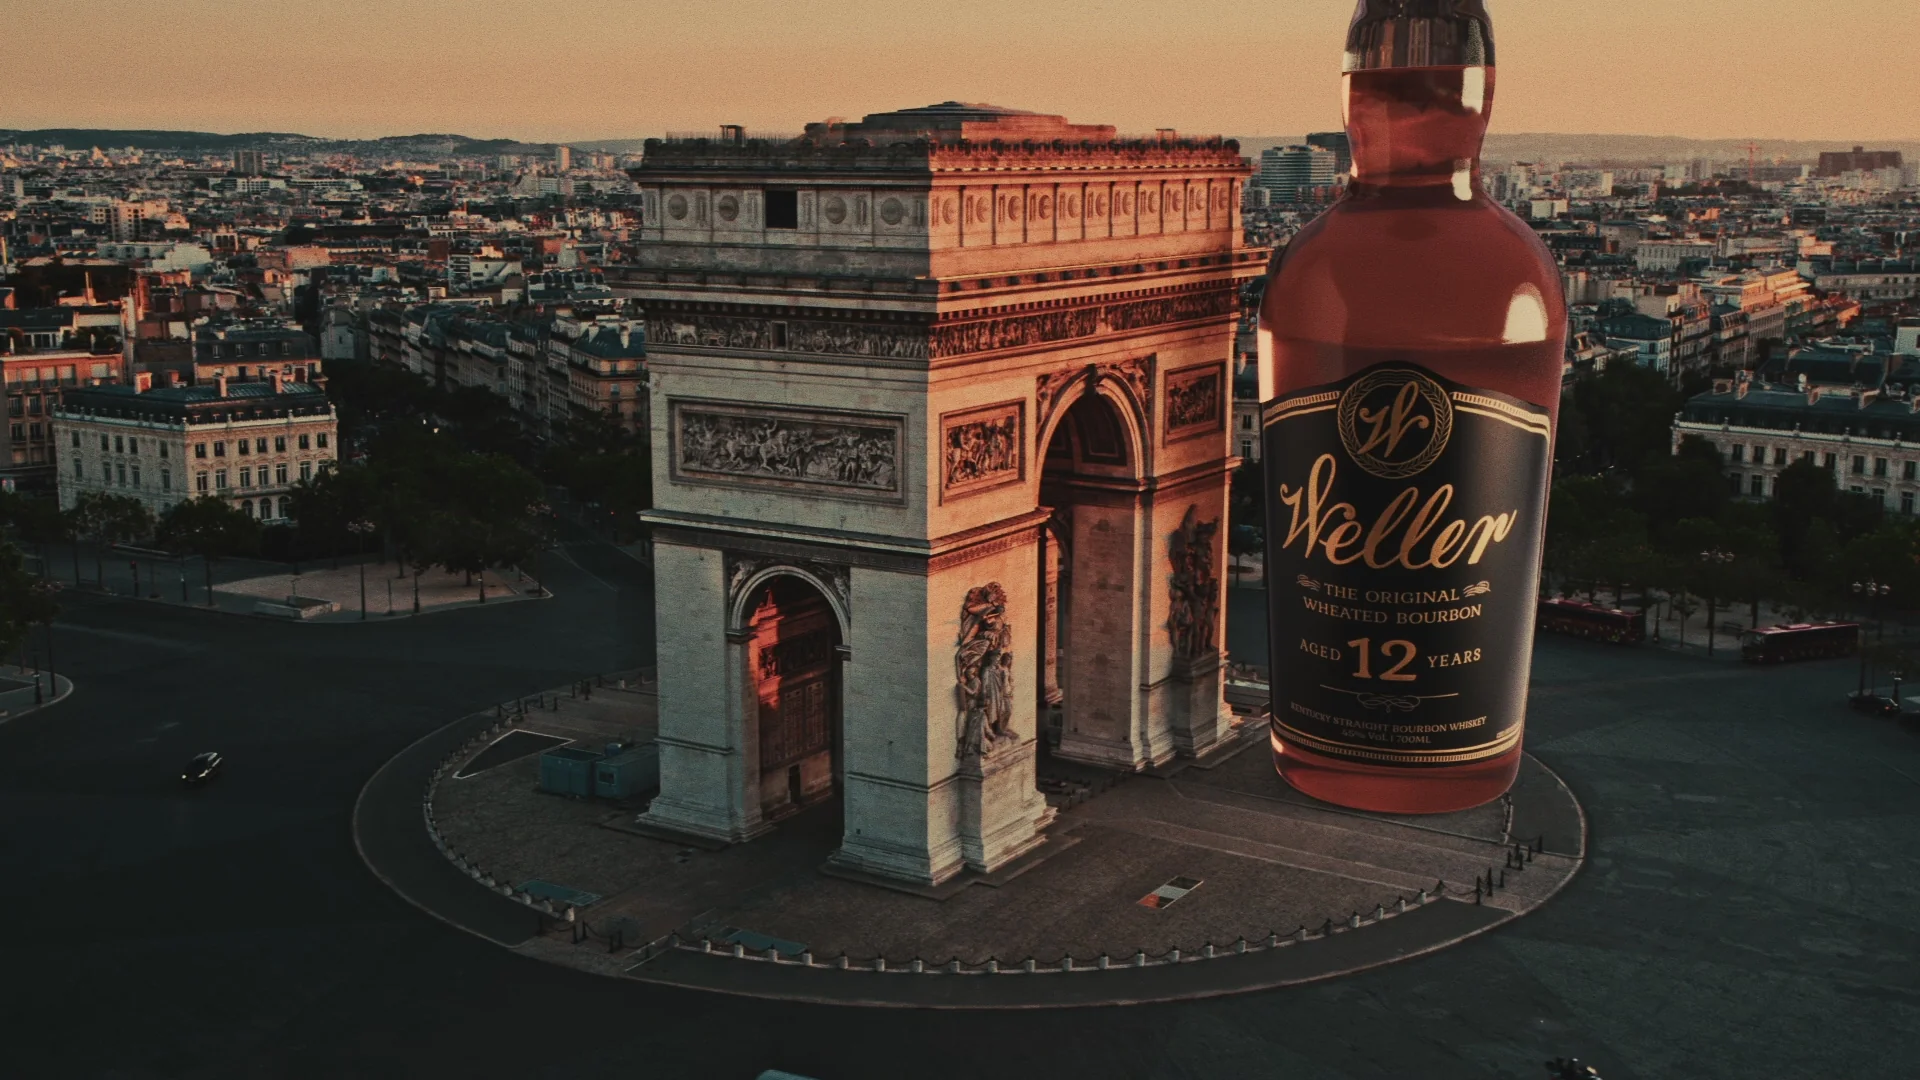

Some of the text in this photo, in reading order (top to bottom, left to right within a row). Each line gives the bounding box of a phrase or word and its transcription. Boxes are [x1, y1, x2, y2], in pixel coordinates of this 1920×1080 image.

[1357, 381, 1430, 458] W
[1279, 453, 1518, 570] Weller
[1303, 596, 1482, 625] WHEATED BOURBON
[1323, 582, 1460, 604] THE ORIGINAL
[1299, 637, 1481, 682] AGED 12 YEARS
[1290, 701, 1331, 723] KENTUCKY
[1333, 716, 1388, 732] STRAIGHT
[1392, 723, 1448, 733] BOURBON
[1449, 716, 1487, 732] WHISKEY
